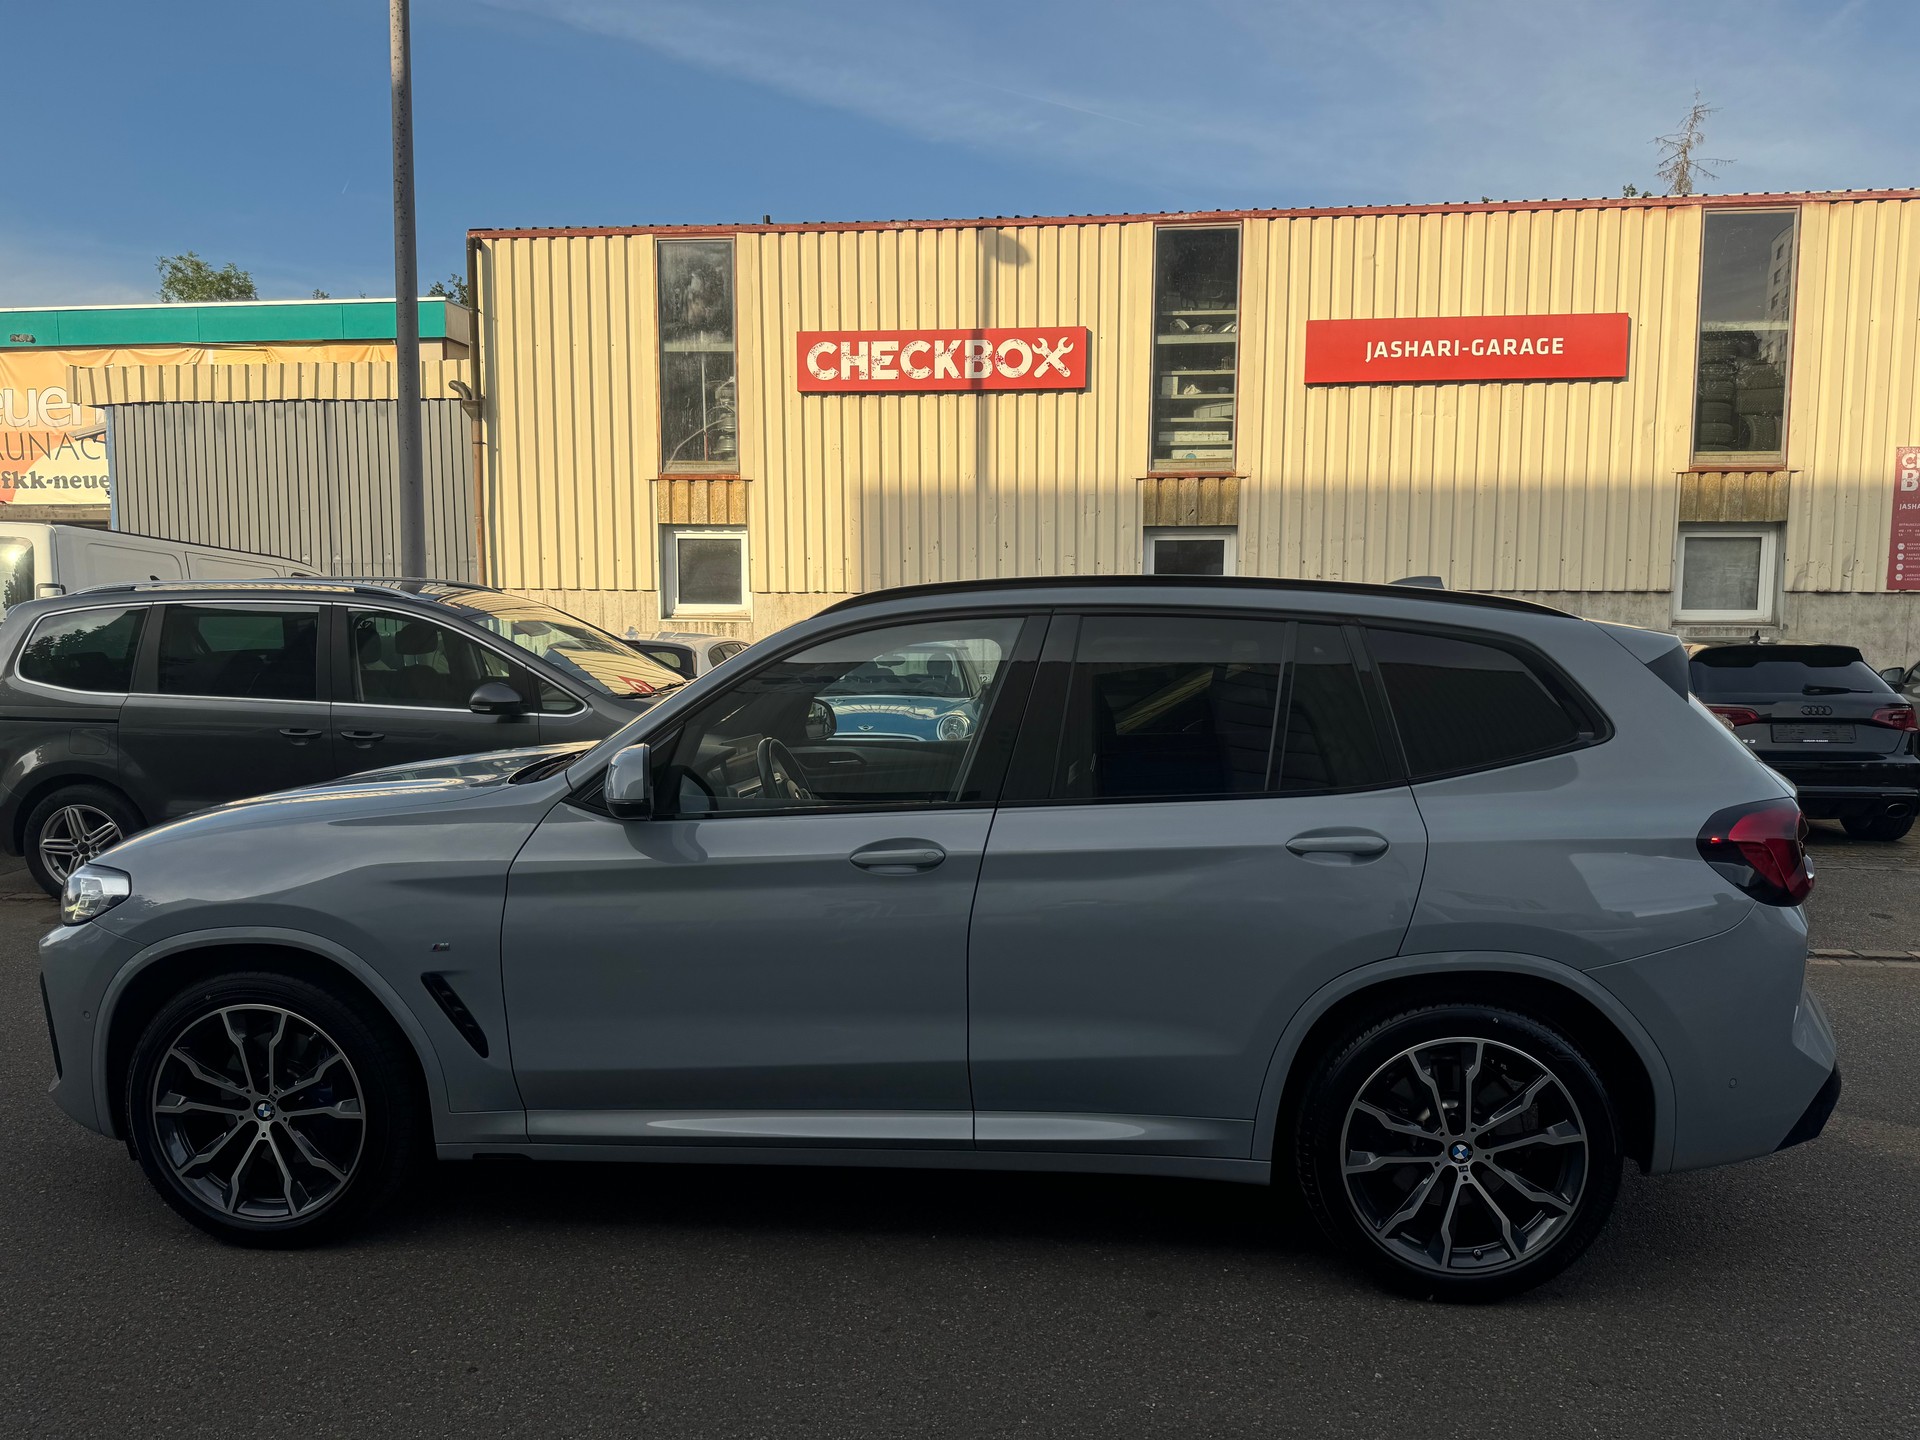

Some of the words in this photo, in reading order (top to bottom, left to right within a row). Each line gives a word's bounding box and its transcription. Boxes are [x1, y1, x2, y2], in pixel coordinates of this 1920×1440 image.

[1365, 337, 1564, 363] JASHARI-GARAGE
[0, 432, 108, 461] UNAC
[1901, 453, 1920, 469] C
